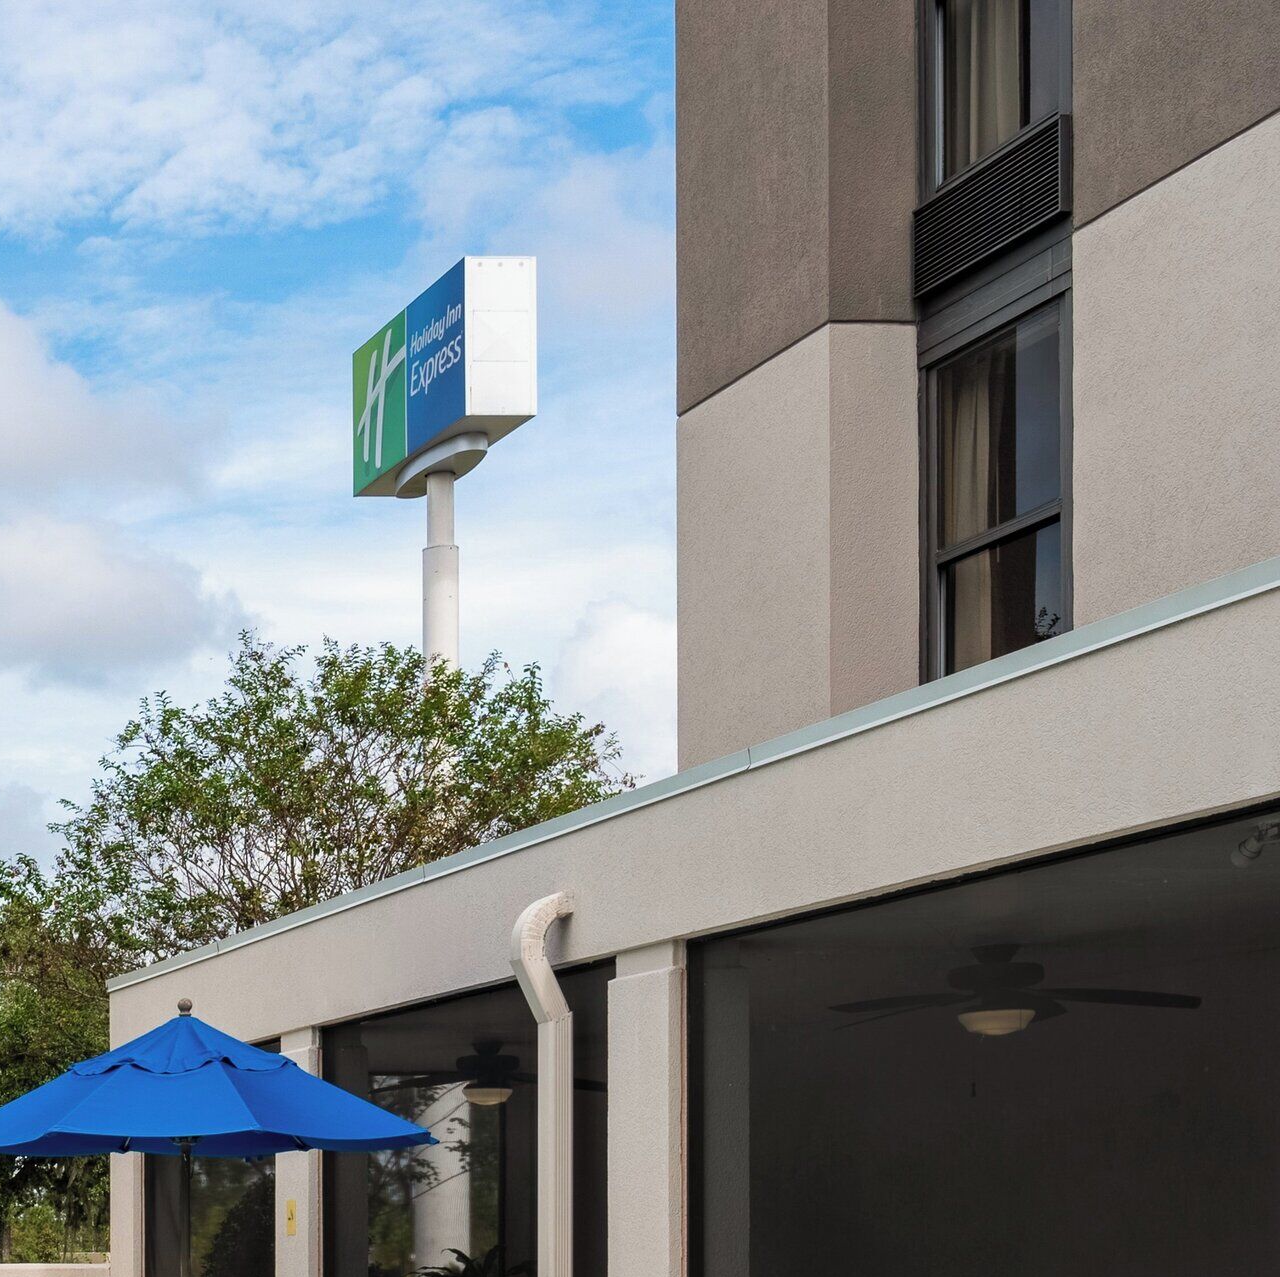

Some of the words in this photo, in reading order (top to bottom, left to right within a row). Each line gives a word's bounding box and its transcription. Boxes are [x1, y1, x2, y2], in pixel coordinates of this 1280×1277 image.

[410, 318, 445, 358] Holiday
[445, 303, 461, 325] Inn
[410, 335, 461, 397] Express
